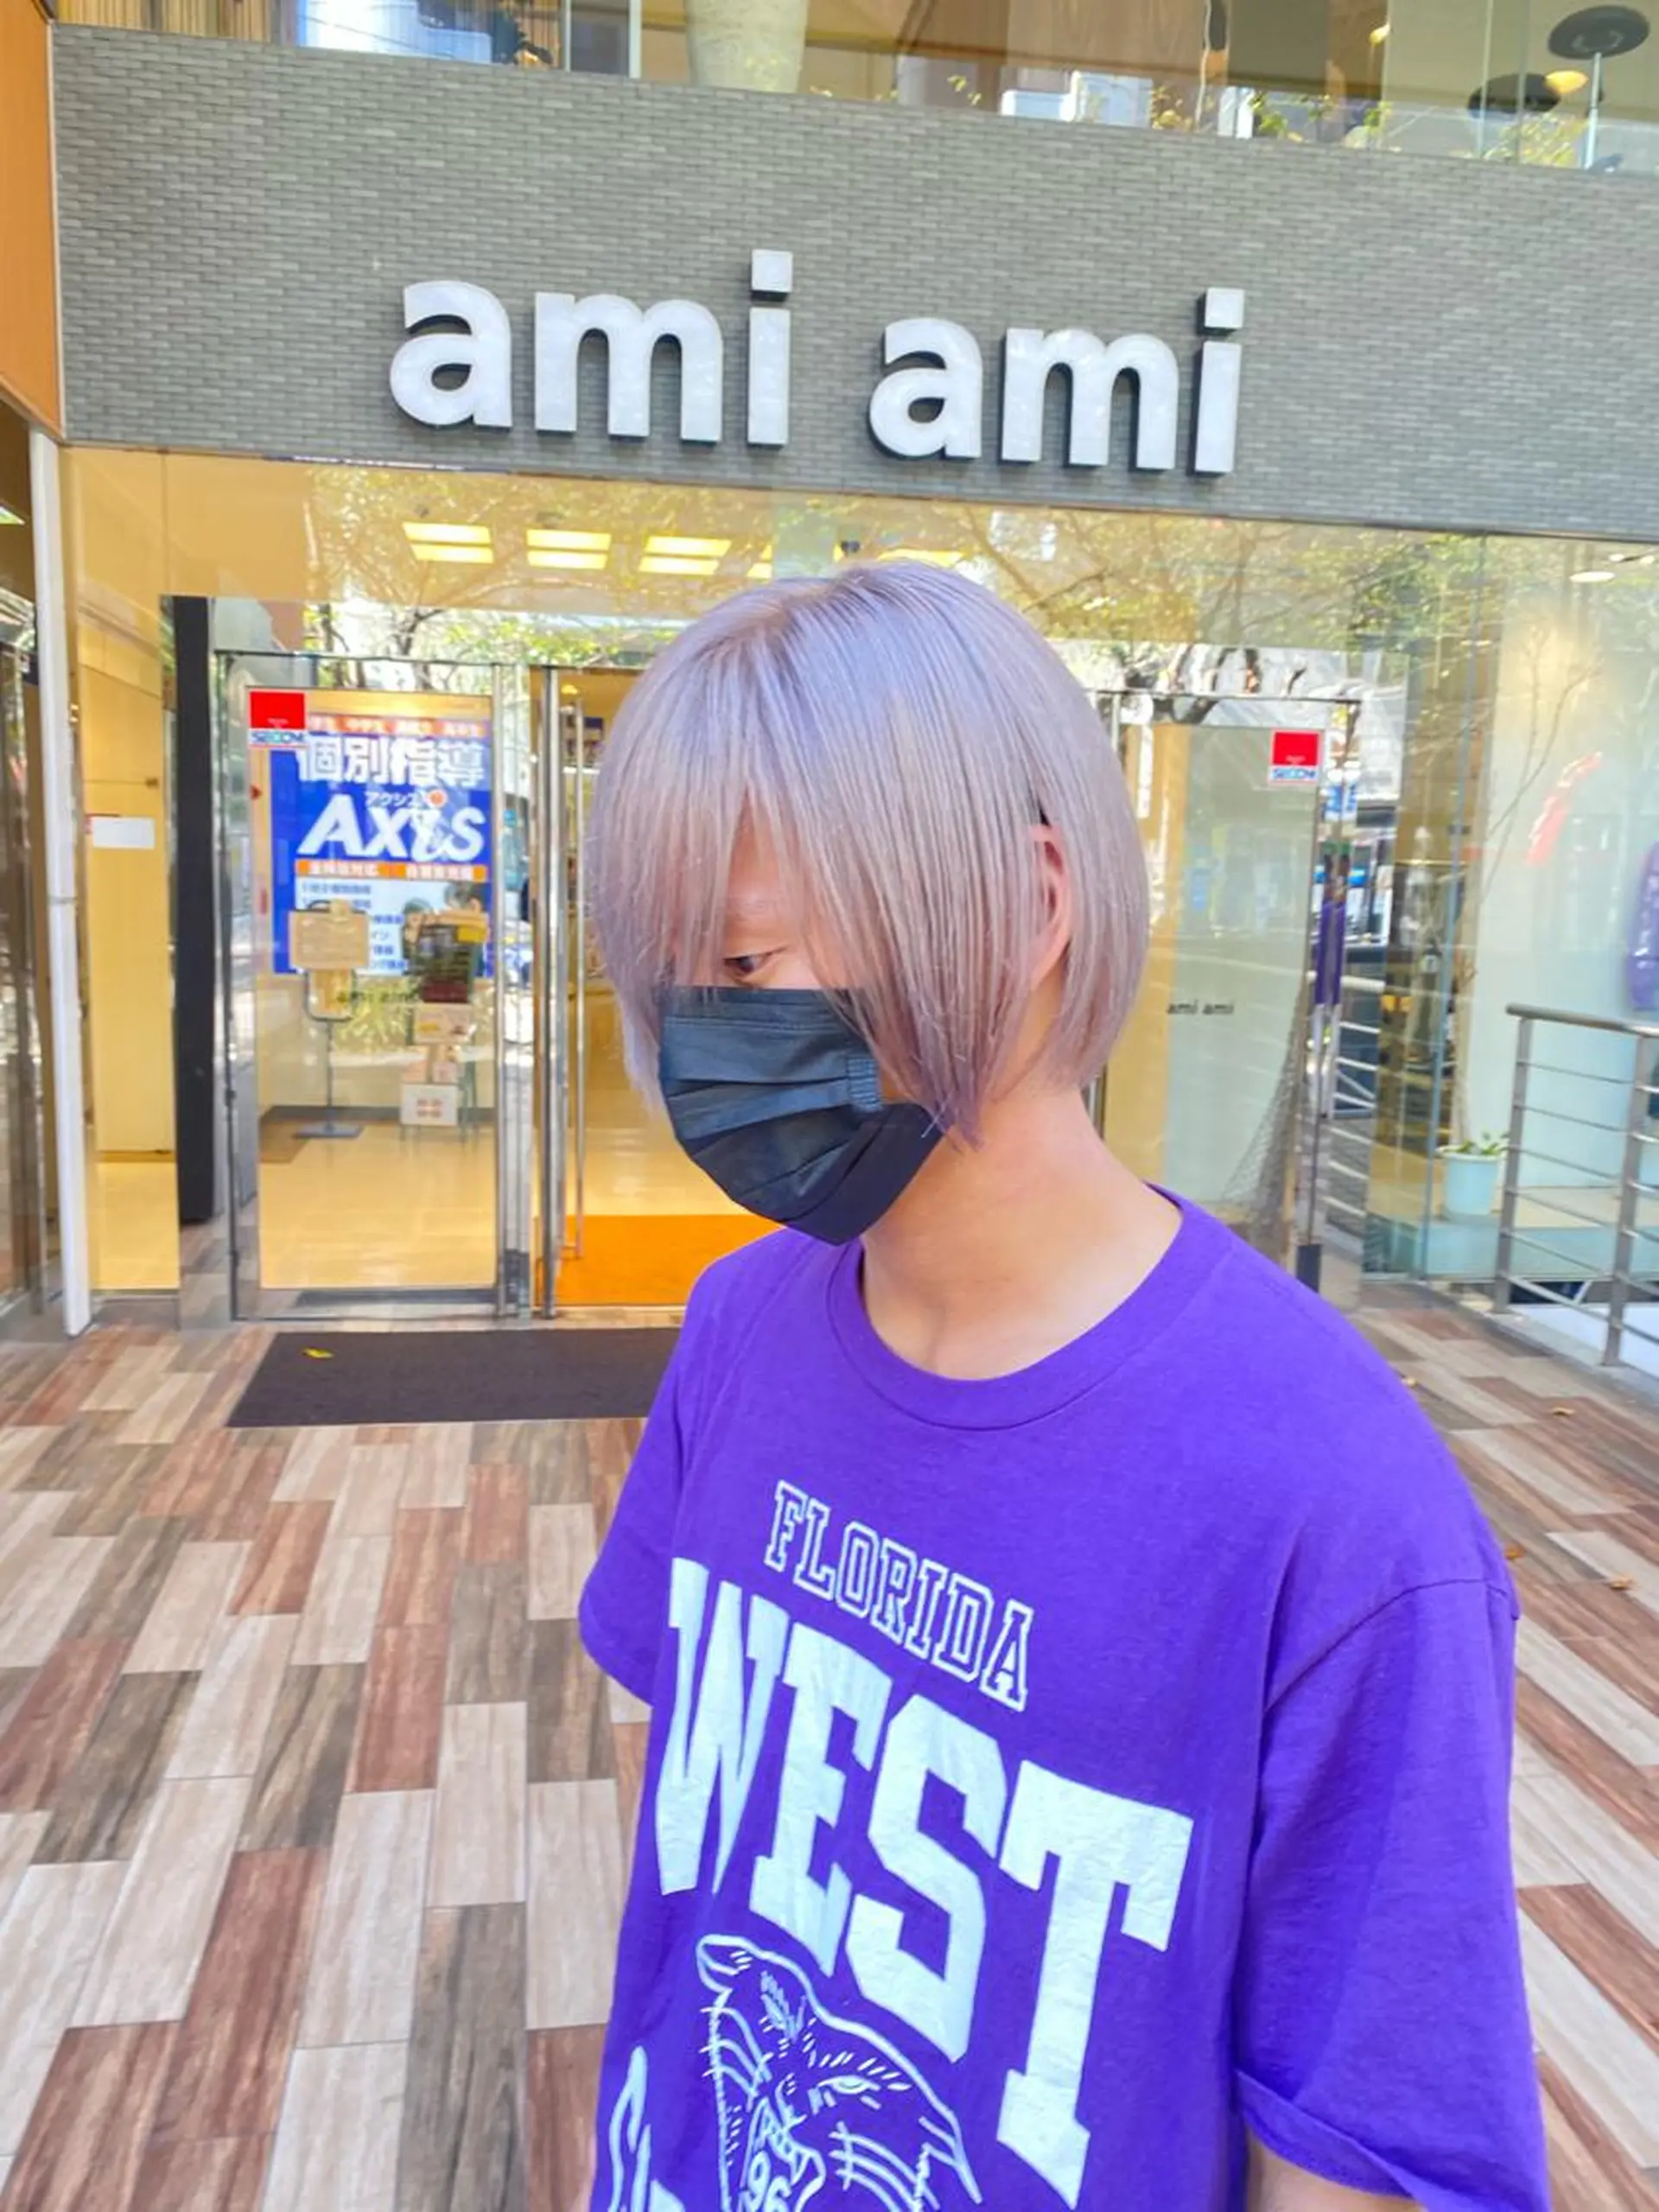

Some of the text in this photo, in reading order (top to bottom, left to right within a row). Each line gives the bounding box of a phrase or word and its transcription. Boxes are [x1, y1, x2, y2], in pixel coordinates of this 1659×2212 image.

[390, 250, 1245, 474] ami ami
[296, 735, 485, 788] 個別指導
[764, 1479, 1035, 1713] FLORIDA
[654, 1557, 1194, 2210] WEST
